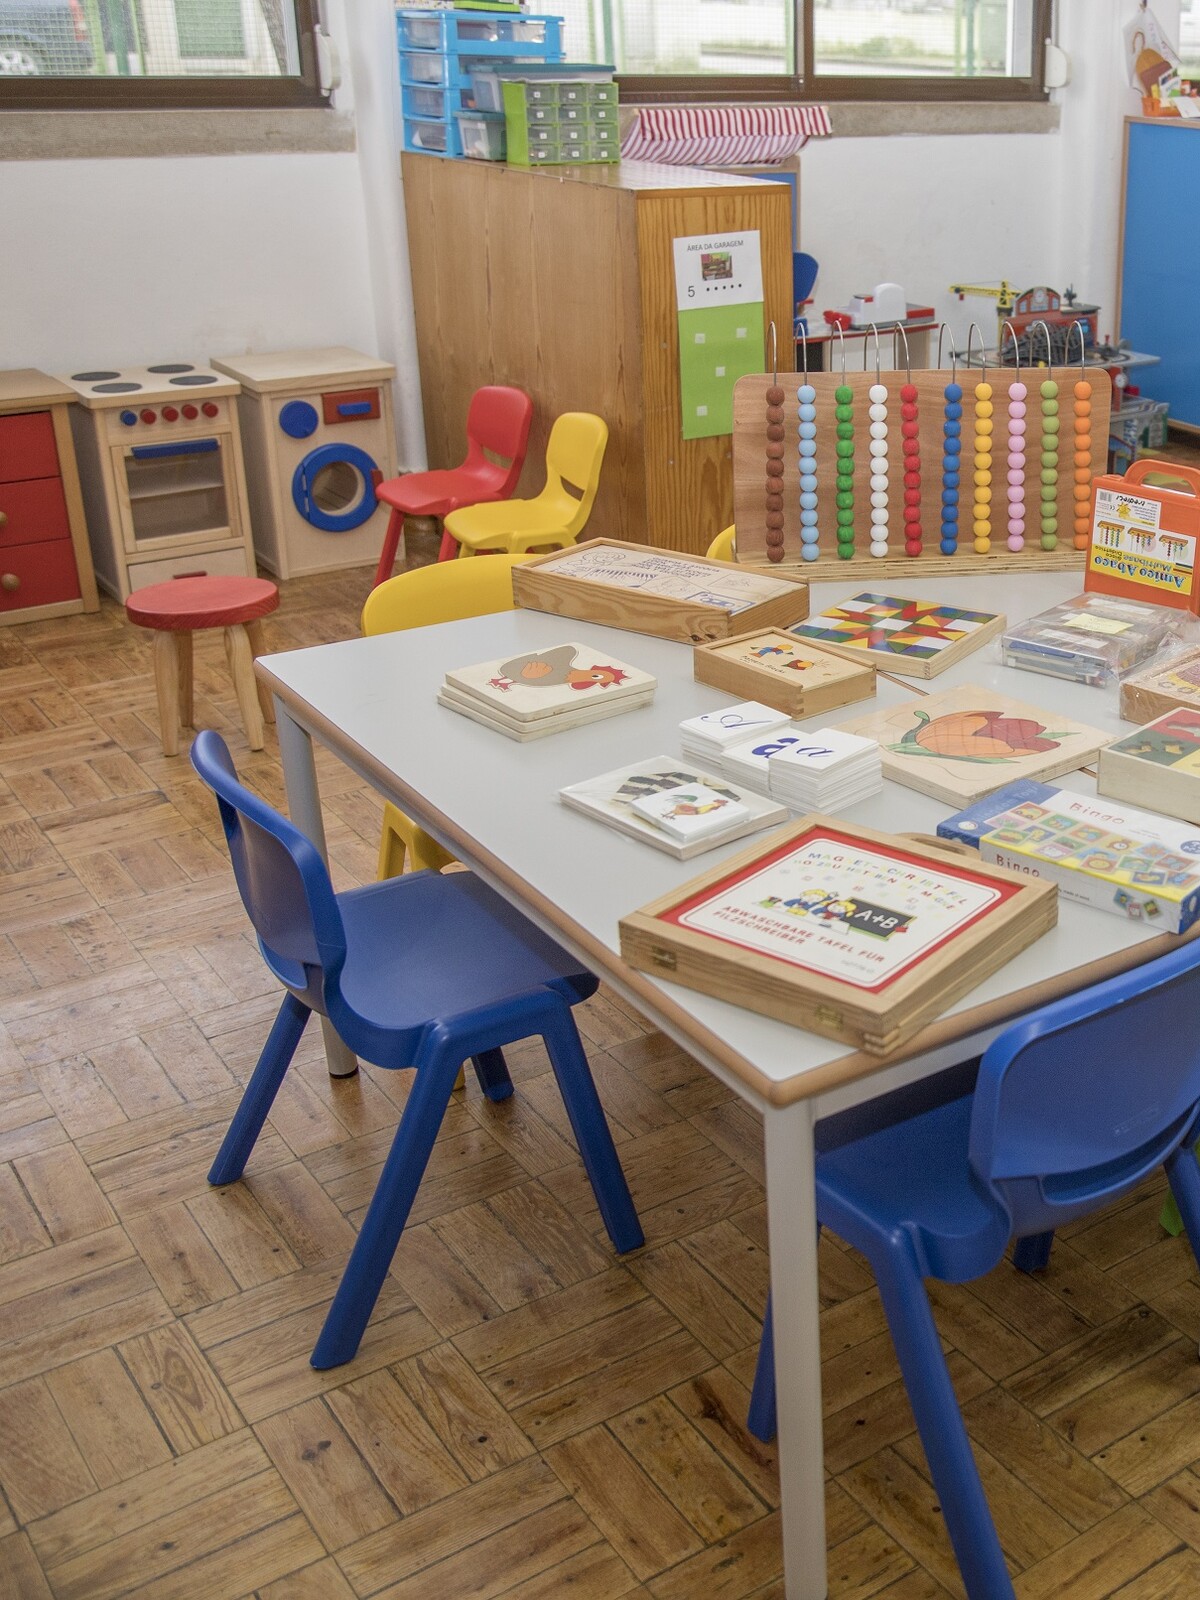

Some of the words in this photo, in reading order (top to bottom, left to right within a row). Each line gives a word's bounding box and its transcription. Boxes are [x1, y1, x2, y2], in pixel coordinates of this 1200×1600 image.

[713, 240, 744, 249] GARAGEM
[687, 285, 696, 298] 5
[1094, 555, 1139, 577] Abaco
[1123, 553, 1172, 573] Multibase
[1141, 568, 1187, 589] Amico
[1068, 802, 1126, 825] Bingo
[995, 854, 1041, 878] Bingo
[712, 911, 806, 945] FILZSCHREIBER
[722, 905, 814, 939] ABWASCHBARE
[817, 936, 853, 953] TAFEL
[854, 909, 899, 929] A+B
